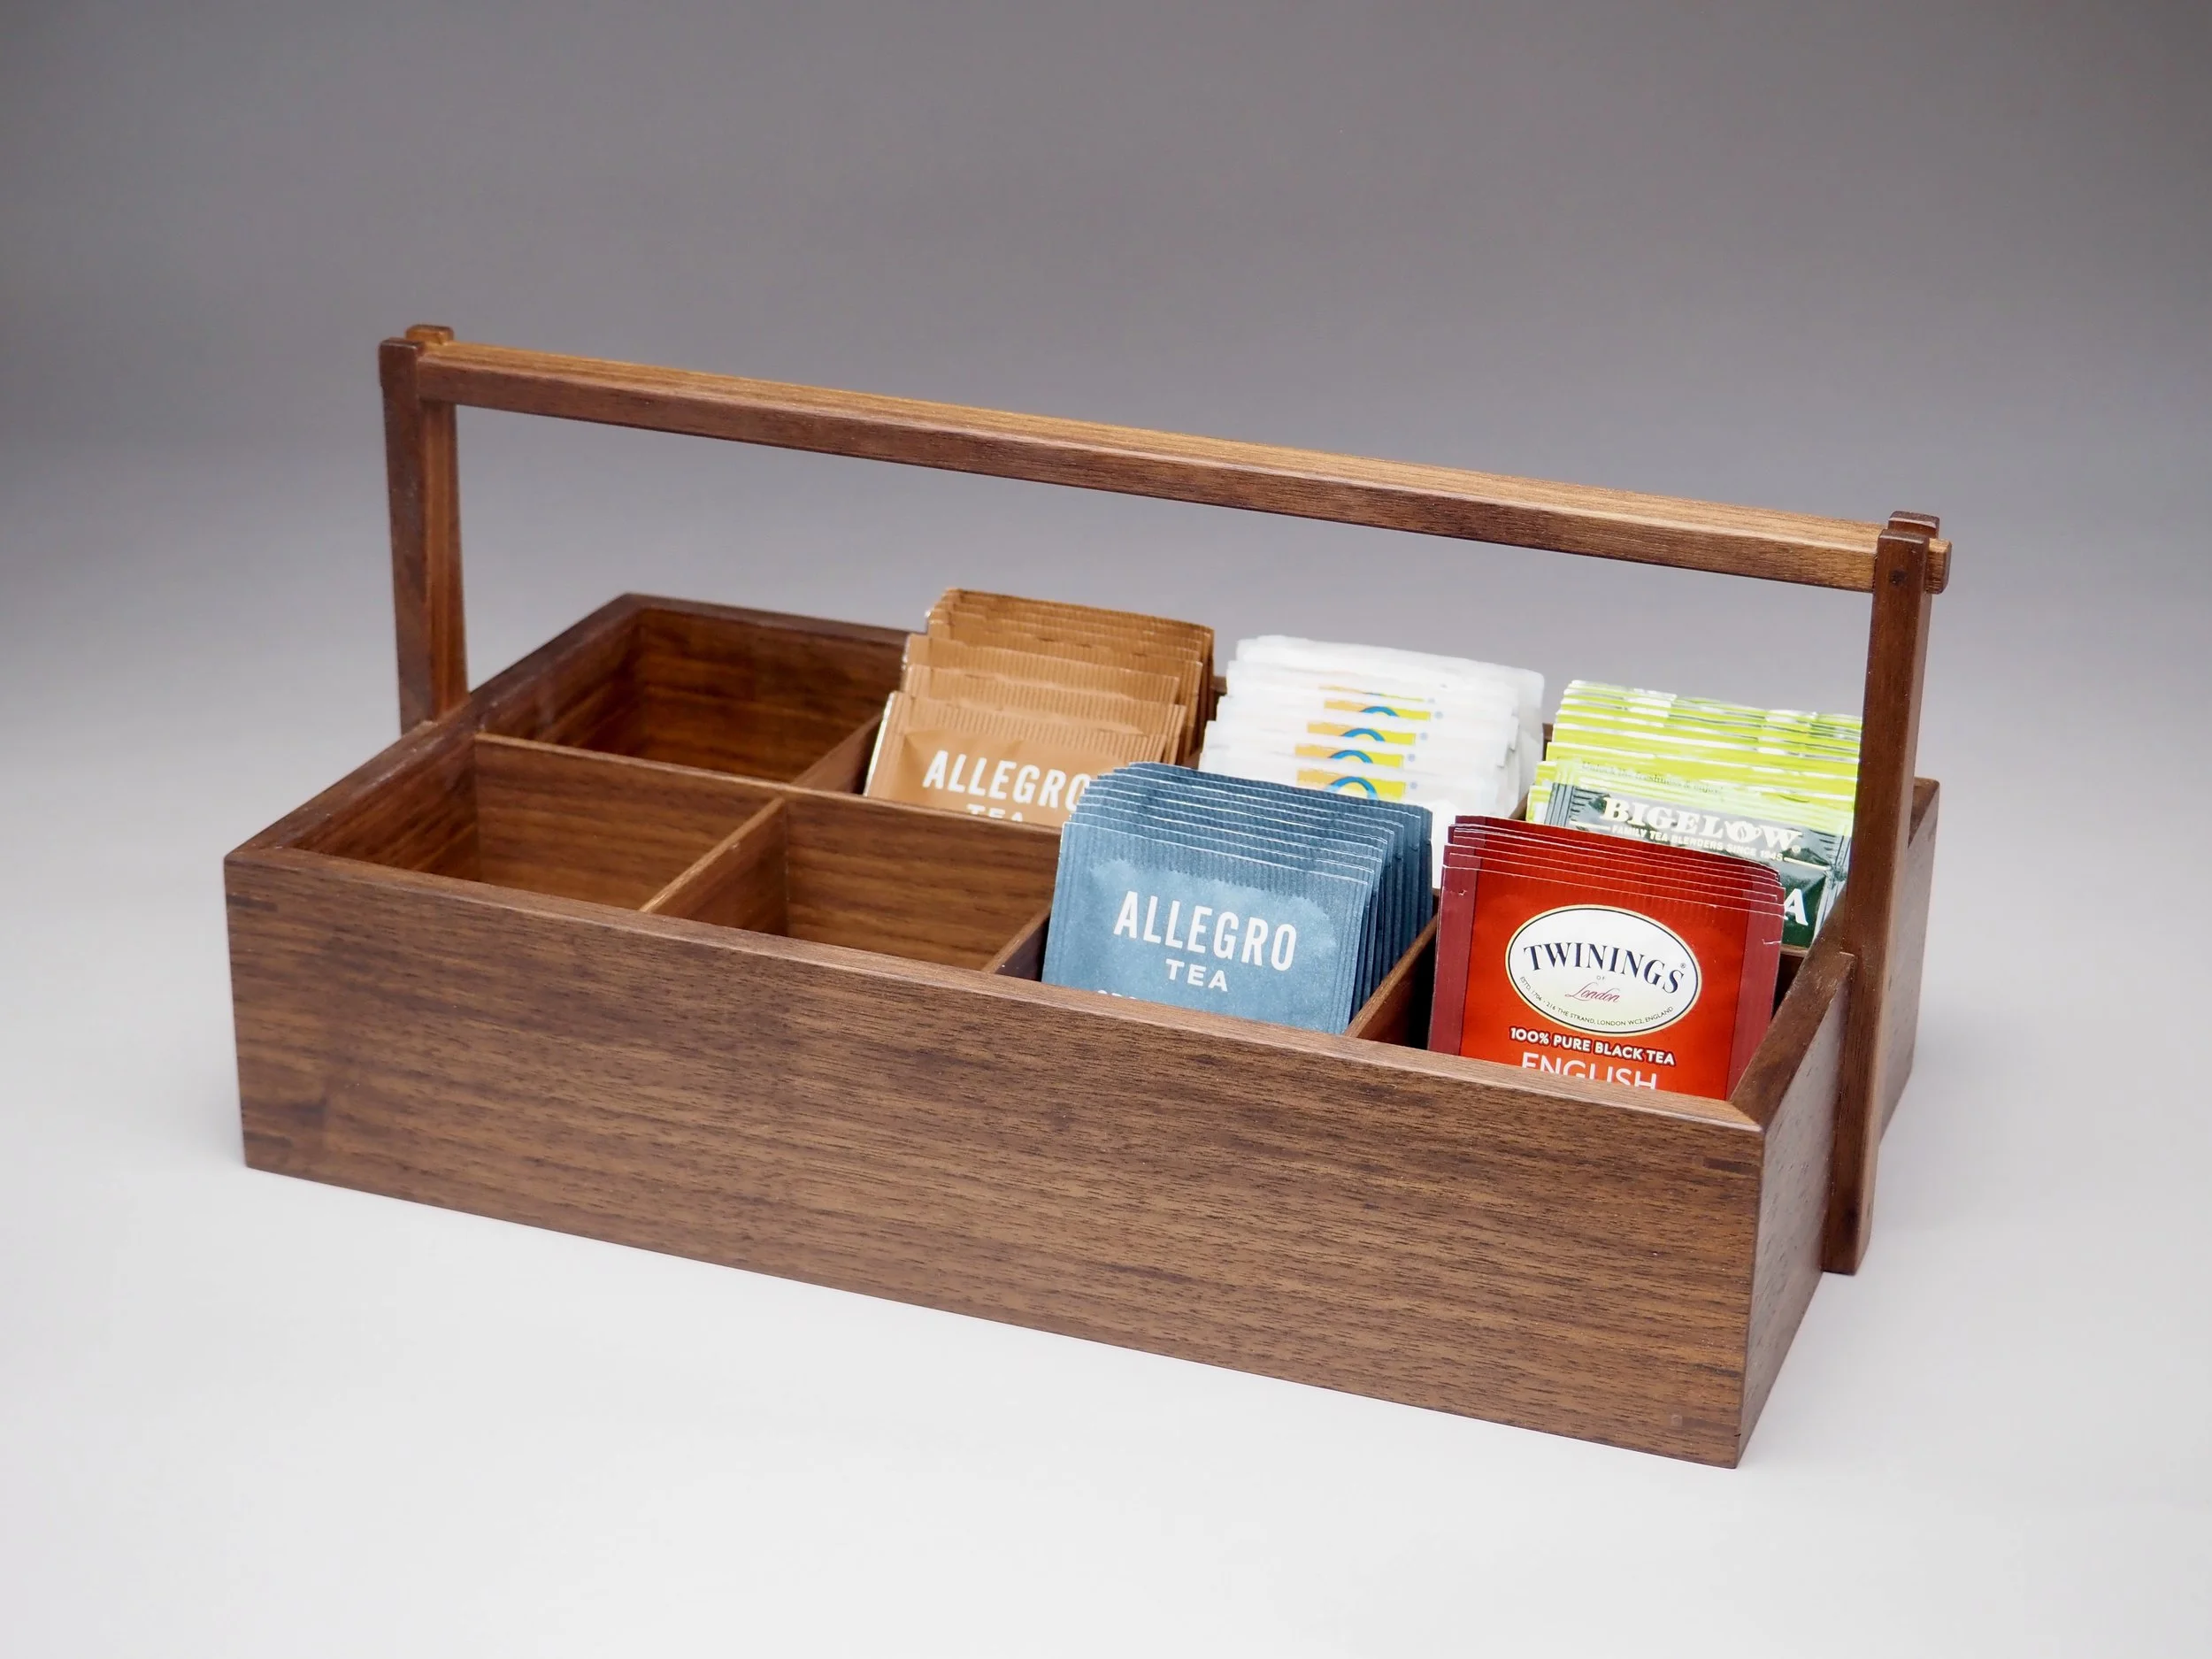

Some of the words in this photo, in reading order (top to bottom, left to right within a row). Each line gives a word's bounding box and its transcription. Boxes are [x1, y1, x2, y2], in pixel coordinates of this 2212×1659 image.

[922, 749, 1092, 812] ALLEGRO
[1600, 795, 1802, 851] BIGELOW
[1610, 824, 1647, 839] FAMILY
[1649, 829, 1669, 843] TEA
[1670, 833, 1724, 851] BLENDERS
[1726, 842, 1758, 858] SINCE
[1113, 890, 1297, 972] ALLEGRO
[1165, 958, 1228, 992] TEA
[1524, 941, 1685, 995] TWININGS
[1564, 981, 1621, 1003] London
[1557, 1007, 1569, 1017] THE
[1570, 1011, 1596, 1025] STRAND,
[1645, 1006, 1674, 1023] ENGLAND
[1511, 1027, 1549, 1045] 100%
[1554, 1034, 1591, 1052] PURE
[1595, 1041, 1643, 1061] BLACK
[1647, 1049, 1675, 1065] TEA
